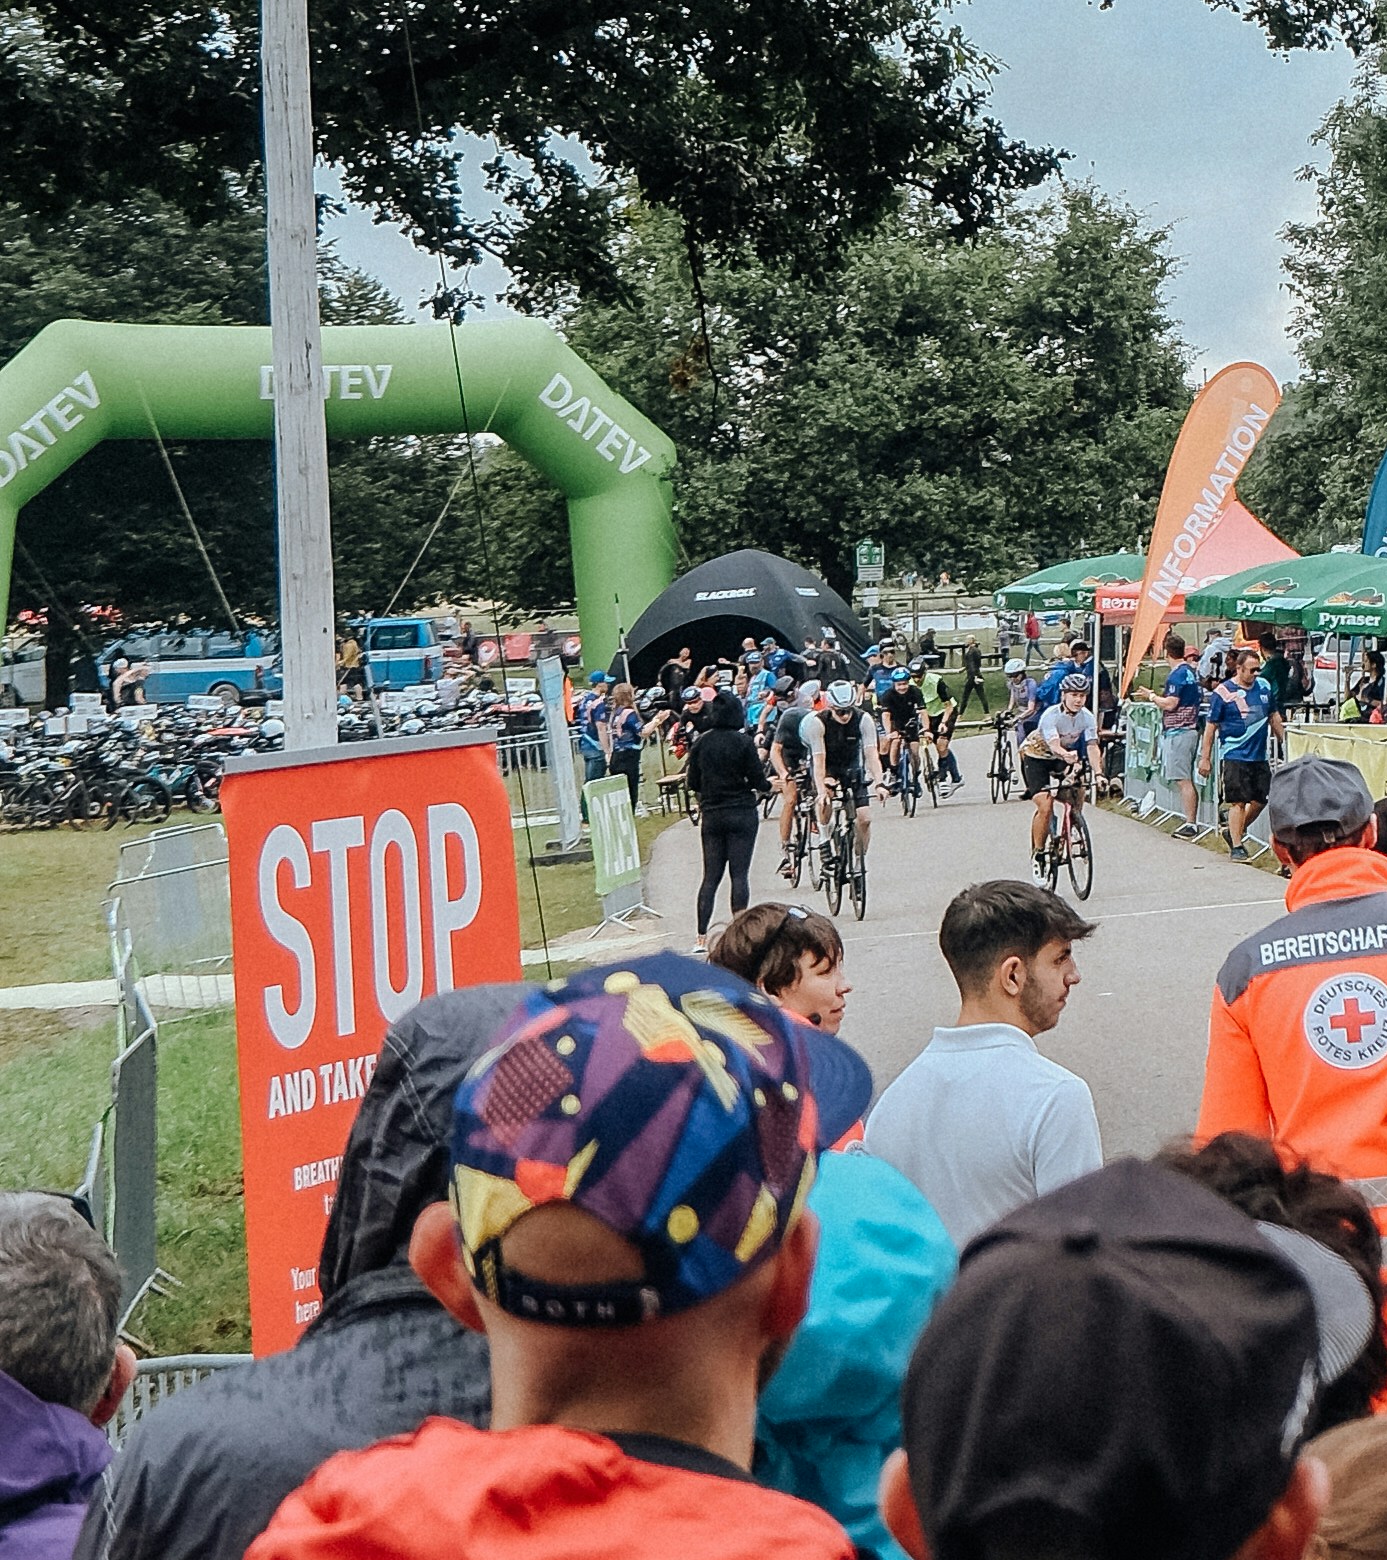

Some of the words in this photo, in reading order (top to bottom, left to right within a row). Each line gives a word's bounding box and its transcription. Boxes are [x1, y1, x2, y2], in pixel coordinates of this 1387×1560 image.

[538, 372, 651, 475] DATEV
[1148, 403, 1270, 607] INFORMATION
[1318, 613, 1381, 632] Pyraser
[259, 802, 482, 1050] STOP
[1313, 1025, 1353, 1062] ROTES
[268, 1068, 317, 1120] AND
[290, 1266, 317, 1292] Your
